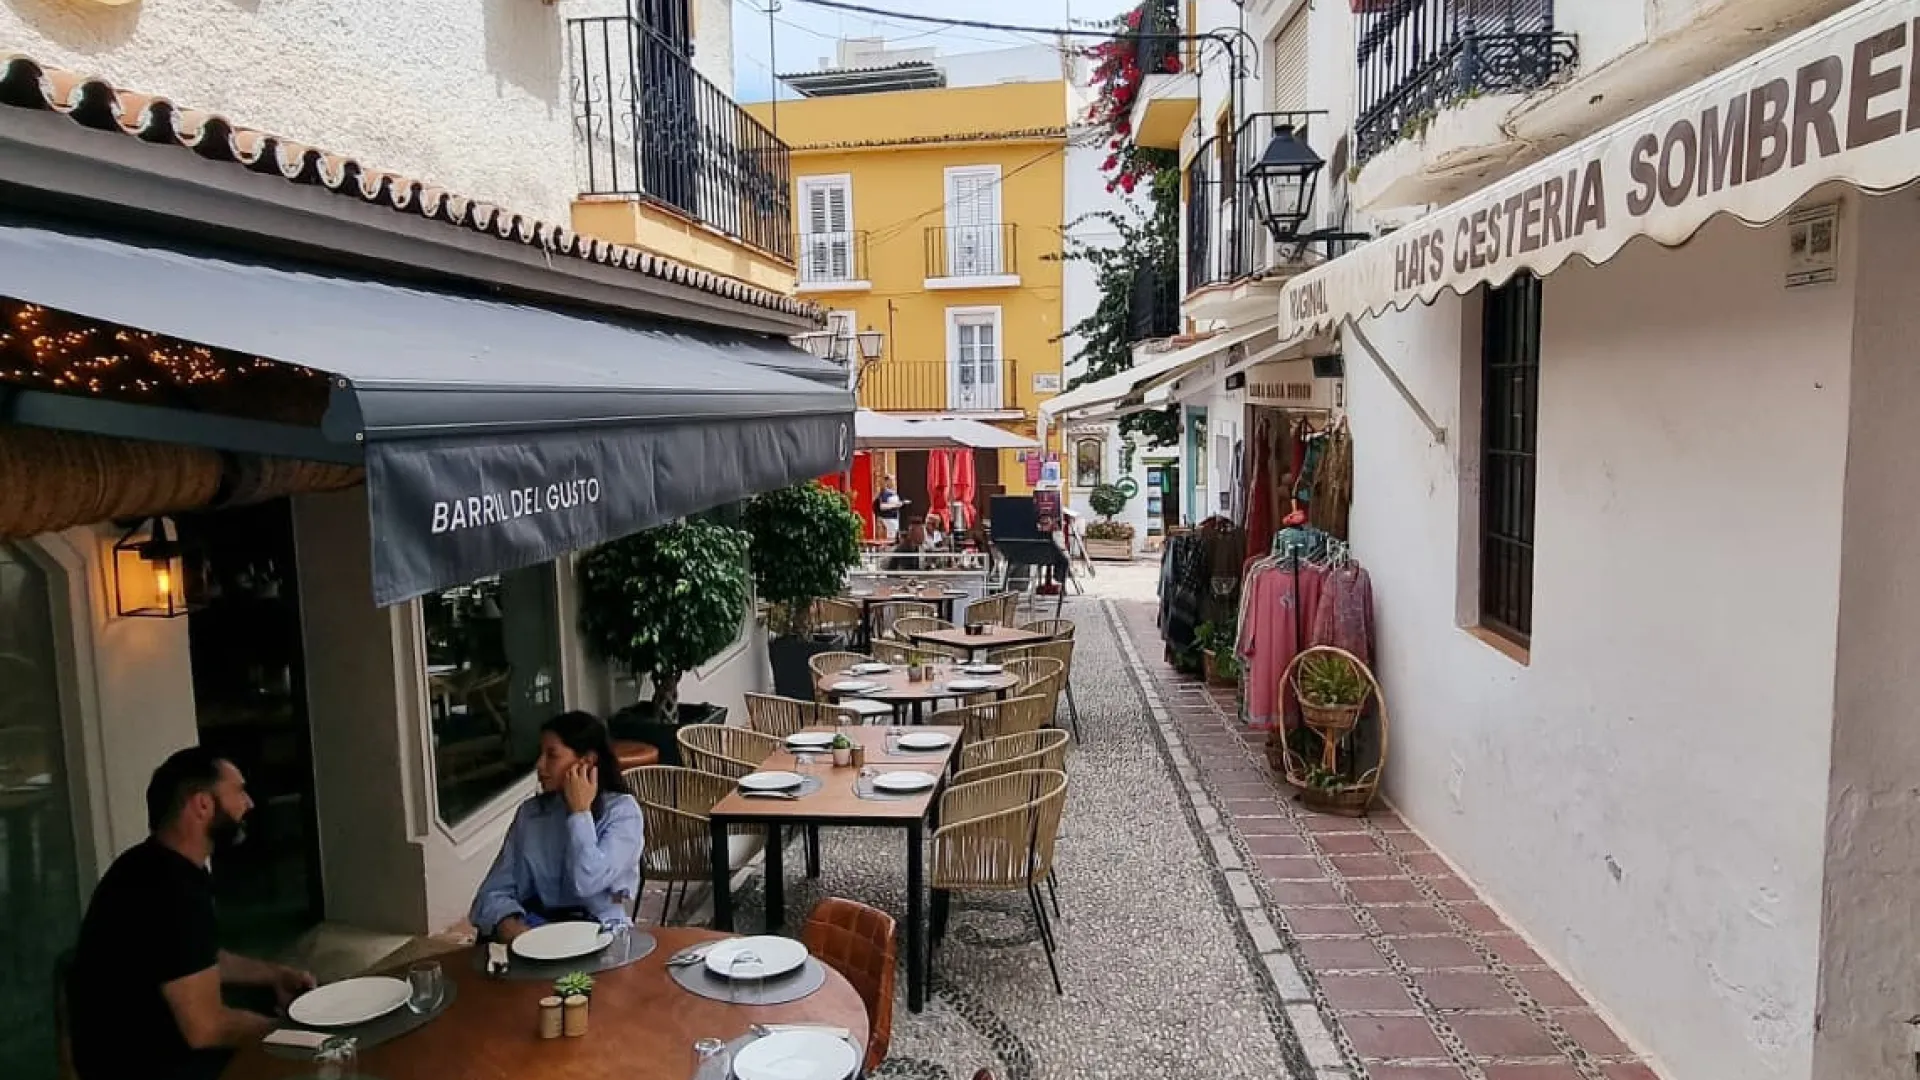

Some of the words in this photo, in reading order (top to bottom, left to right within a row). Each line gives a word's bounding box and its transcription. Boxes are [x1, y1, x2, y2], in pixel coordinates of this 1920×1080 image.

[1393, 228, 1444, 292] HATS
[1452, 158, 1606, 275] CESTERIA
[1626, 16, 1920, 217] SOMBRE
[431, 493, 509, 534] BARRIL
[510, 486, 543, 518] DEL
[545, 478, 600, 510] GUSTO
